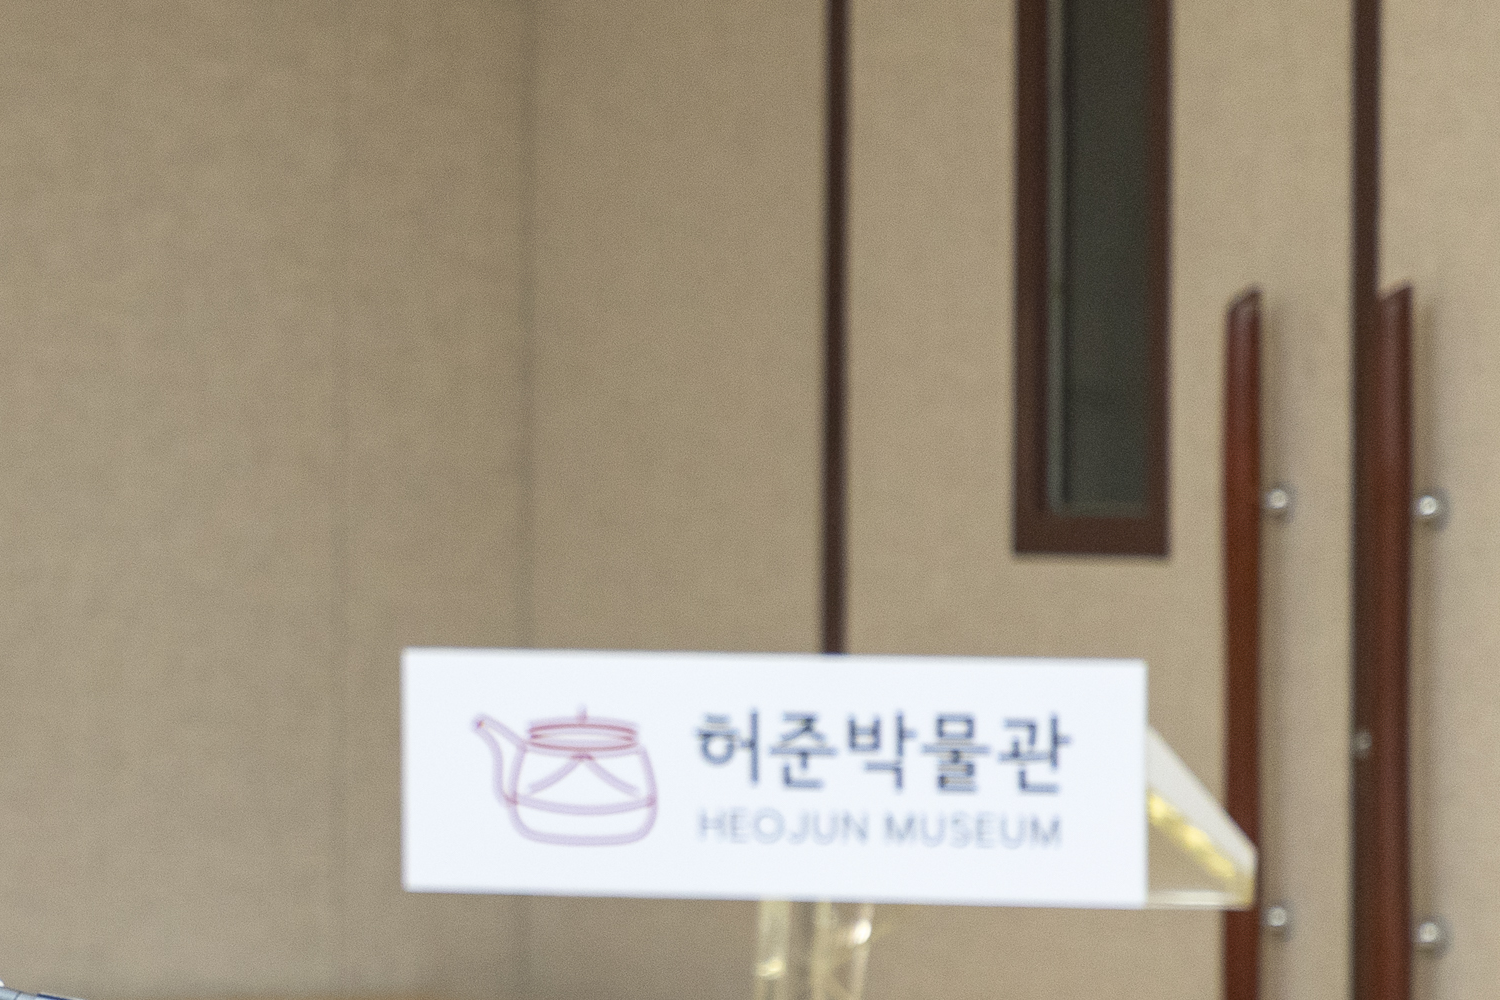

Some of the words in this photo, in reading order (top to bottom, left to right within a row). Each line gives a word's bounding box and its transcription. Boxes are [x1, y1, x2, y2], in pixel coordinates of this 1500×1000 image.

[695, 706, 1072, 795] 허준박물관
[698, 805, 870, 848] HEOJUN
[883, 809, 1063, 850] MUSEUM
